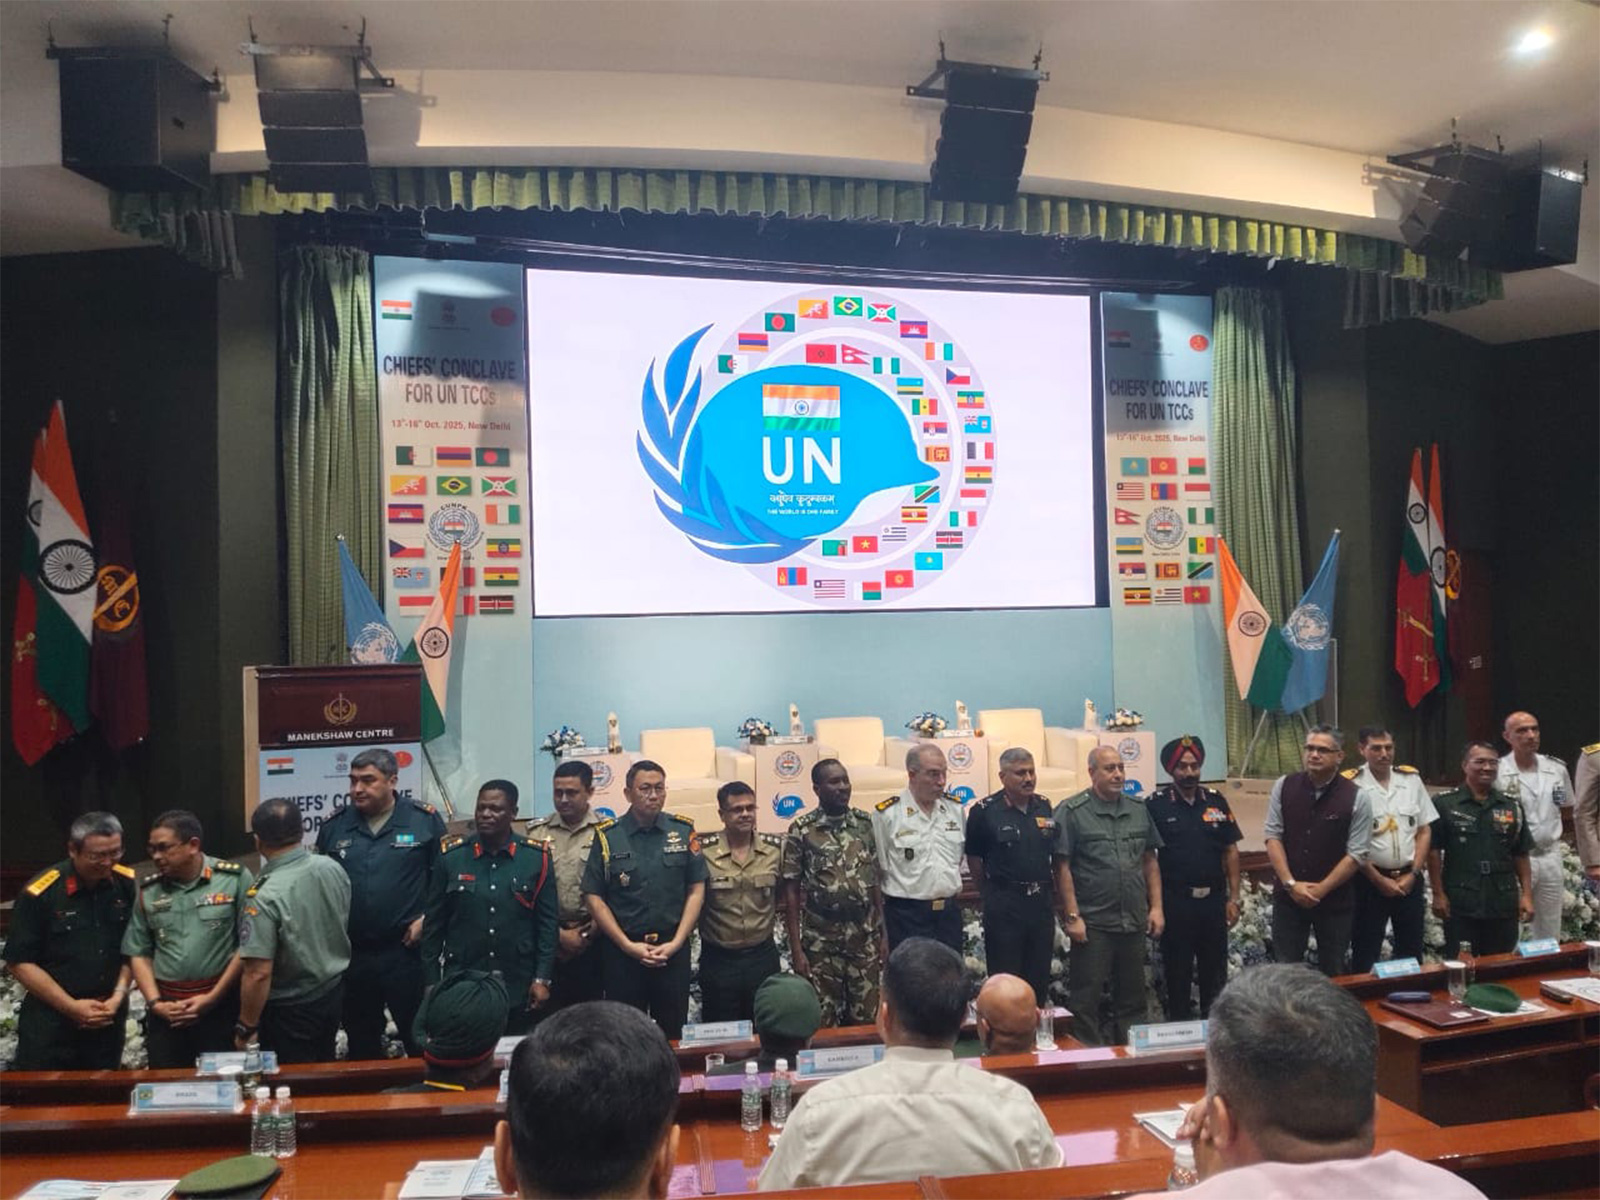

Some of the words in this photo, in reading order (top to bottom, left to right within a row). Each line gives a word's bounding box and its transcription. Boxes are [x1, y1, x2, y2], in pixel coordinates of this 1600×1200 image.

[383, 355, 437, 377] CHIEFS'
[440, 357, 516, 380] CONCLAVE
[405, 383, 433, 404] FOR
[437, 384, 457, 405] UN
[461, 384, 496, 406] TCCs
[1109, 379, 1150, 396] CHIEFS'
[1151, 380, 1209, 398] CONCLAVE
[1126, 402, 1147, 420] FOR
[1149, 402, 1165, 421] UN
[1167, 403, 1194, 421] TCCs
[468, 422, 487, 430] New
[489, 422, 511, 431] Delhi
[762, 436, 841, 484] UN
[287, 731, 354, 742] MANEKSHAW
[355, 729, 394, 739] CENTRE
[782, 799, 795, 809] UN
